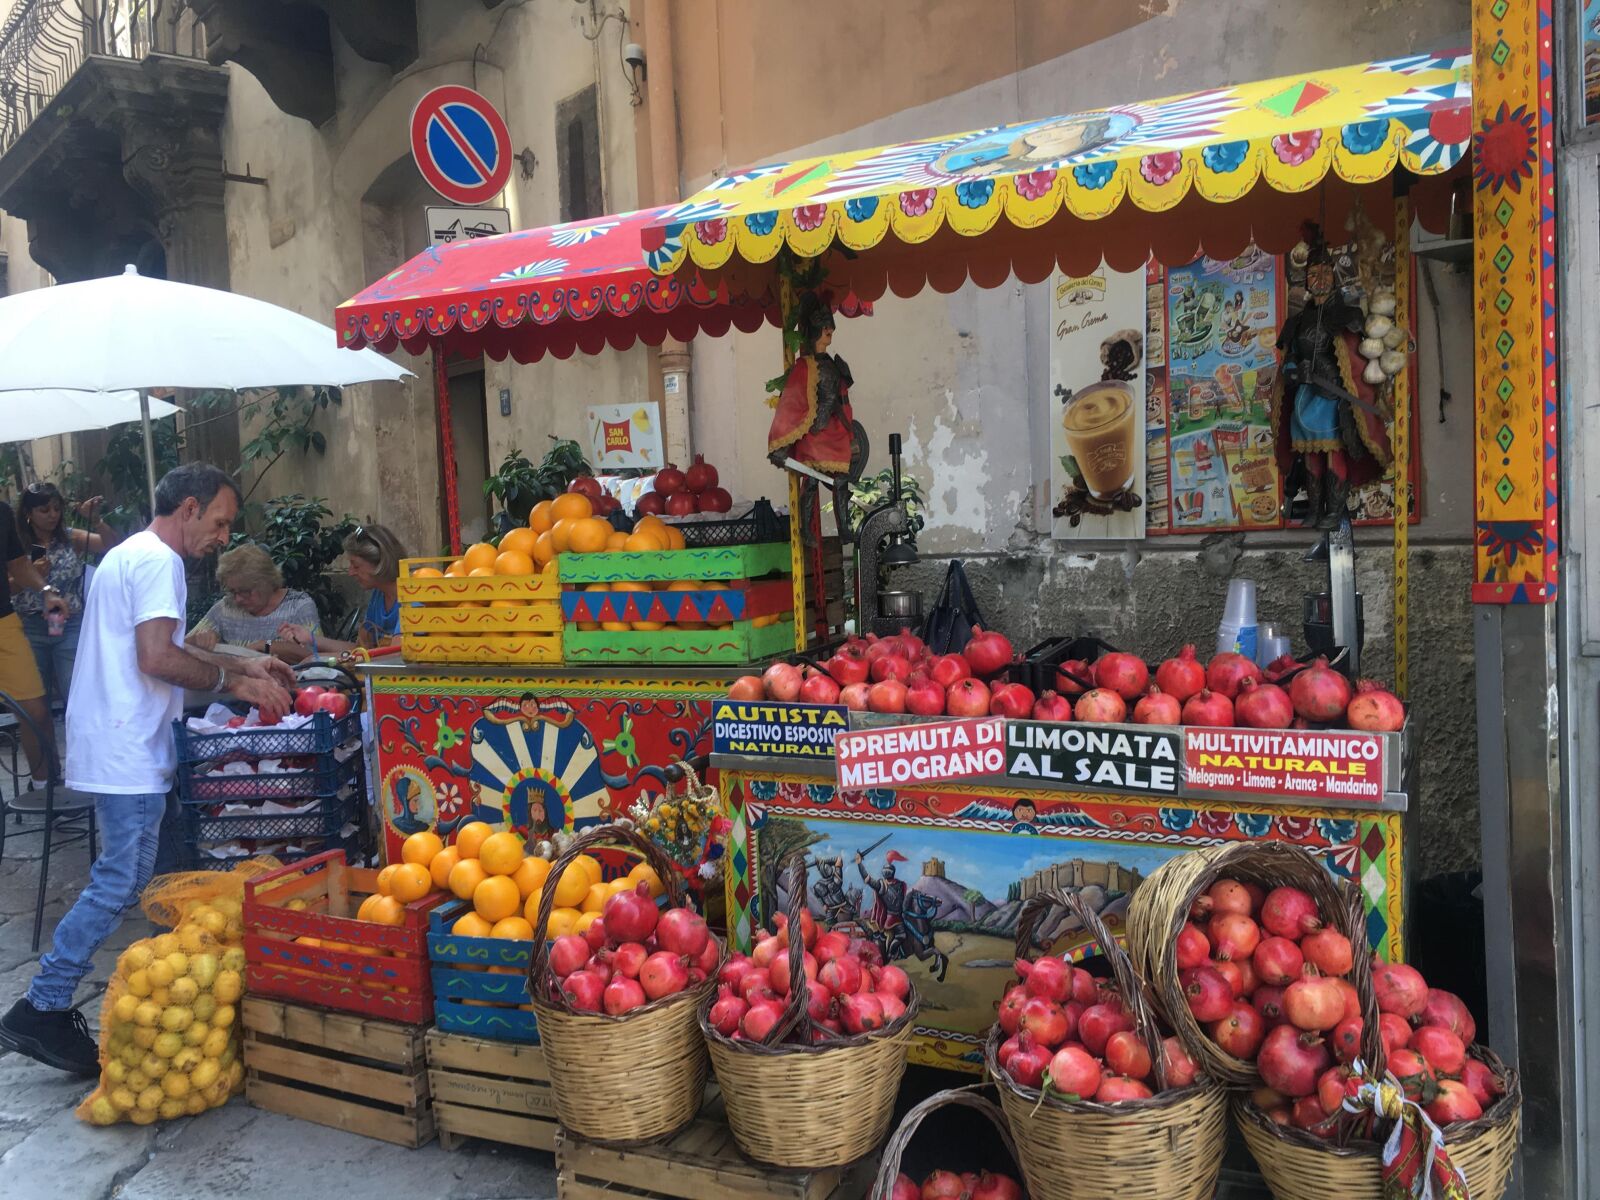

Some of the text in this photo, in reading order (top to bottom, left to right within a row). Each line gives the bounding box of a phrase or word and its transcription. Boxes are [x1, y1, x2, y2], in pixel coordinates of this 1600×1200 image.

[1056, 319, 1080, 341] Gran
[606, 436, 629, 446] CARLO
[608, 428, 623, 437] SAN
[715, 705, 847, 726] AUTISTA
[715, 723, 847, 744] DIGESTIVO ESPOSIV
[839, 722, 1003, 760] SPREMUTA DI
[1008, 725, 1176, 761] LIMONATA
[729, 741, 836, 756] NATURALE
[1187, 732, 1380, 761] MULTIVITAMINICO
[840, 748, 1004, 788] MELOGRANO
[1009, 752, 1176, 791] AL SALE
[1199, 754, 1367, 776] NATURALE
[1188, 768, 1235, 787] Melograno
[1243, 772, 1276, 789] Limone
[1285, 776, 1317, 791] Arance
[1326, 778, 1378, 796] Mandarino
